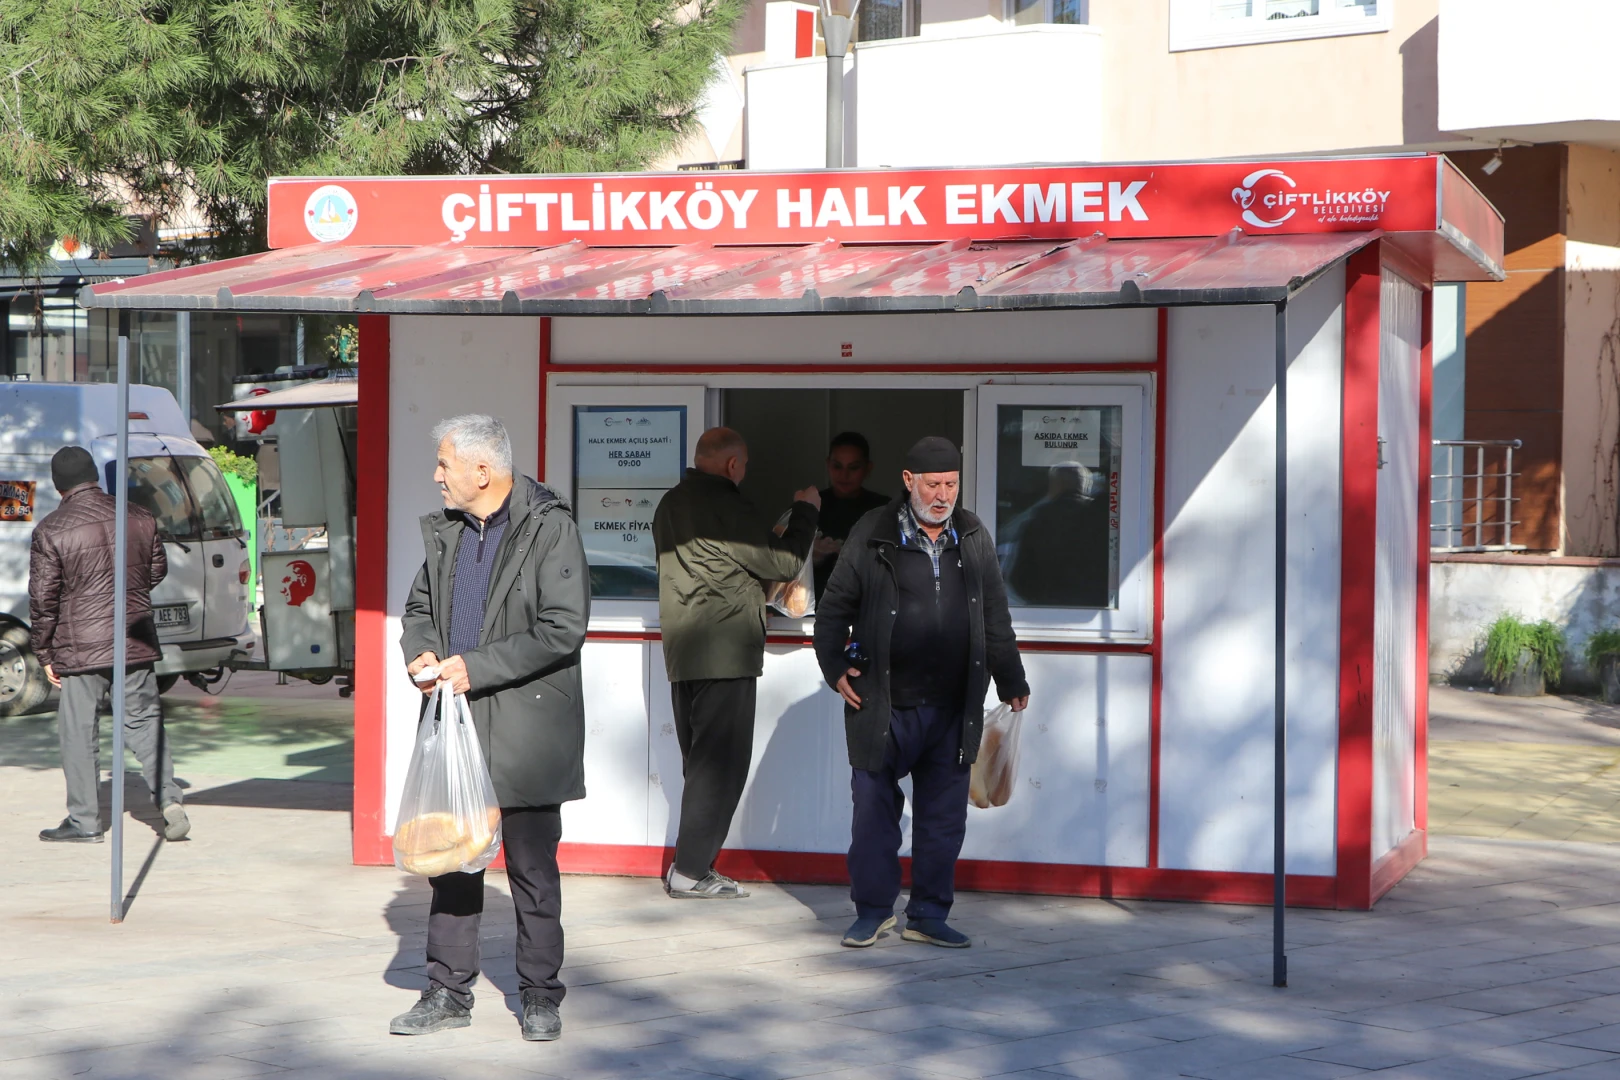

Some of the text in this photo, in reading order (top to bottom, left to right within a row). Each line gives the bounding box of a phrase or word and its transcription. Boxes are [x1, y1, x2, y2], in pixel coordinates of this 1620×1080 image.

[1263, 188, 1391, 209] ÇİFTLİKKÖY
[441, 180, 1149, 242] ÇİFTLİKKÖY HALK EKMEK
[1314, 204, 1384, 214] BELEDİYESİ
[1034, 432, 1089, 441] ASKIDA EKMEK
[1044, 441, 1079, 449] BULUNUR
[608, 450, 651, 458] HER SABAH
[1110, 472, 1118, 513] APLAS
[594, 522, 626, 530] EKMEK
[159, 609, 172, 621] AEE
